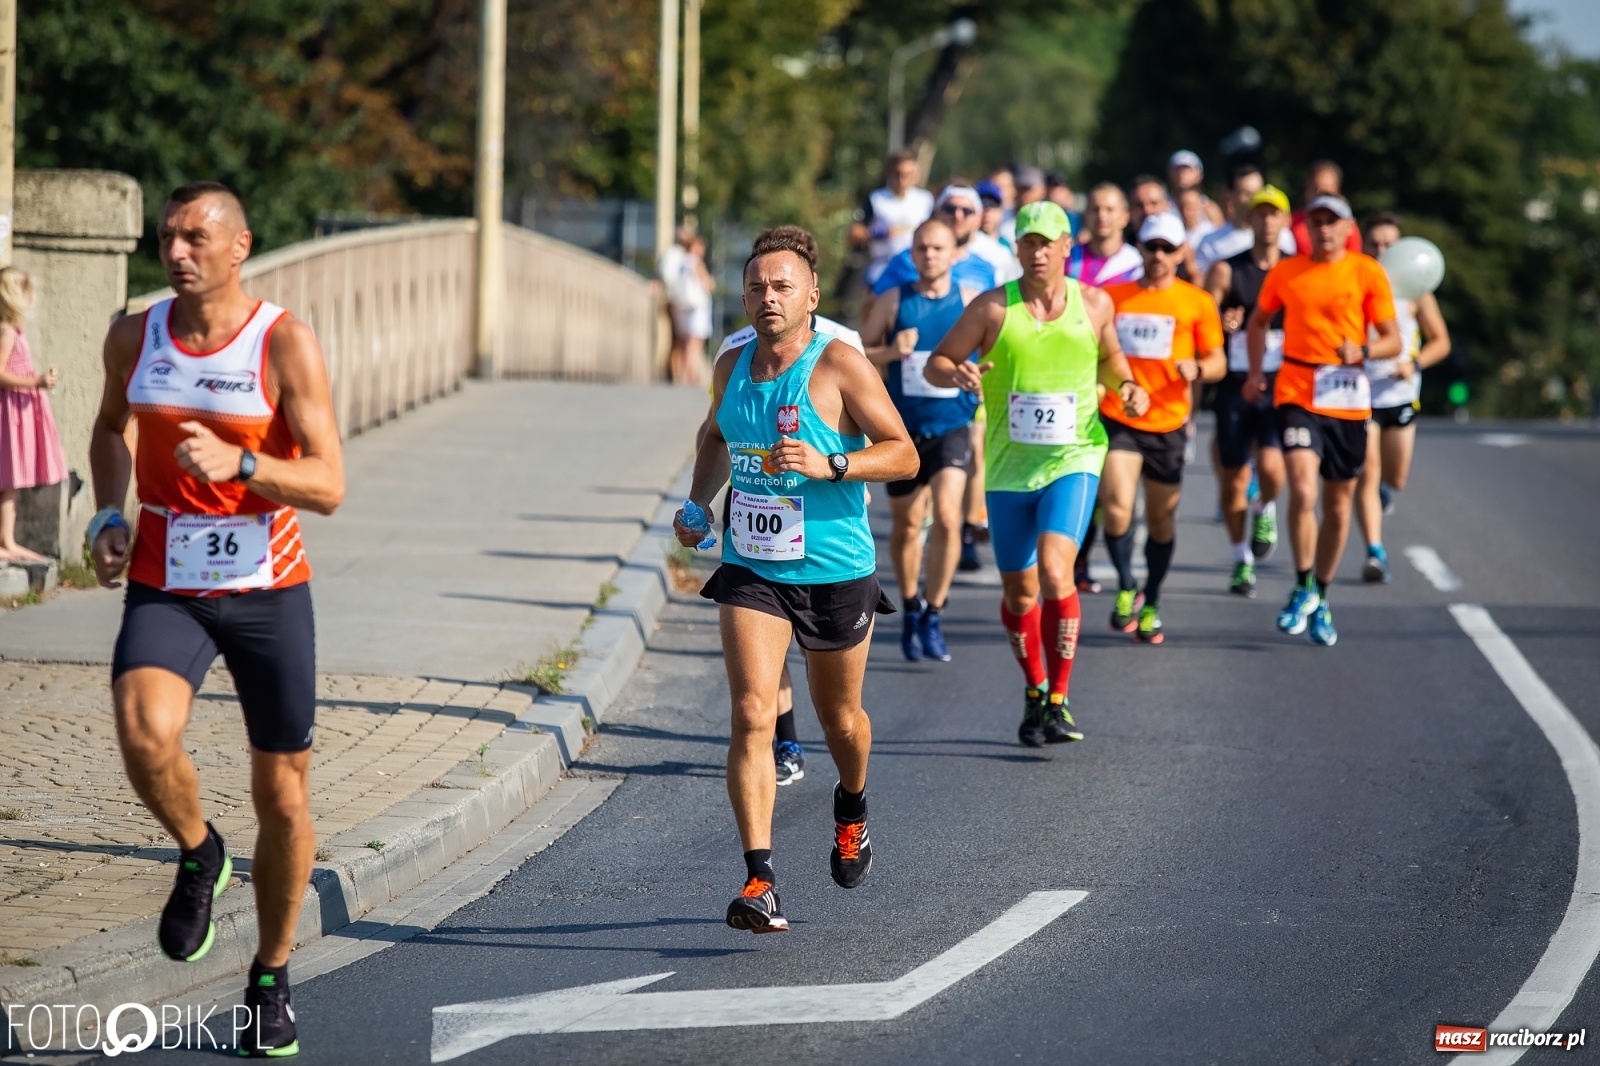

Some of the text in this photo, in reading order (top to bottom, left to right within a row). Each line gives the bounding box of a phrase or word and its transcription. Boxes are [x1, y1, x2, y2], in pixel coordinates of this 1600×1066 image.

[1034, 408, 1055, 424] 92
[735, 475, 798, 488] www.ensol.pl
[747, 511, 783, 535] 100
[206, 532, 239, 557] 36
